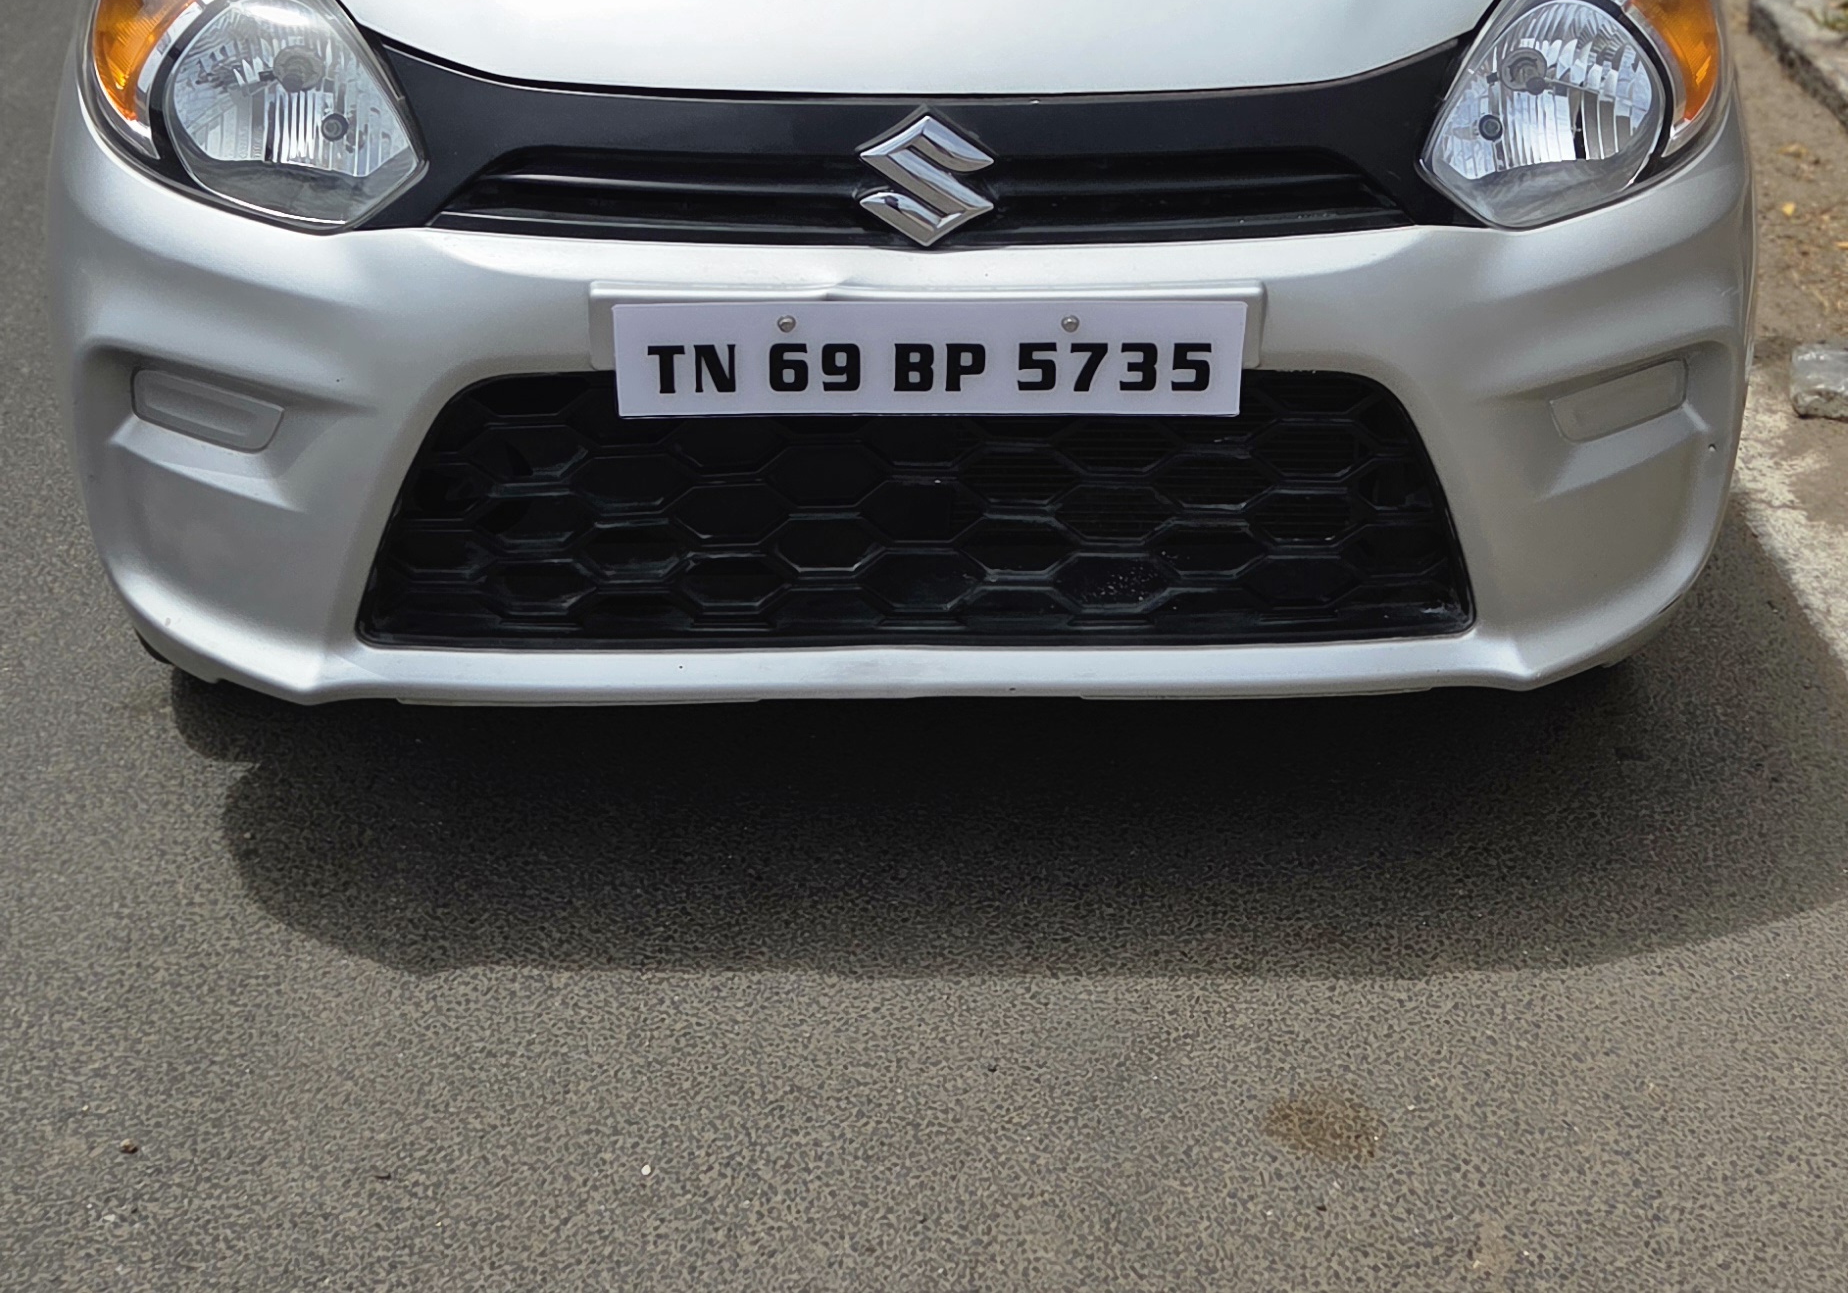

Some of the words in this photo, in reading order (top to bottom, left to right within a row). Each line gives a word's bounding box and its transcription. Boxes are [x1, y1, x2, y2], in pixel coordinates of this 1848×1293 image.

[647, 343, 737, 395] TN
[768, 342, 861, 393] 69
[893, 342, 986, 393] BP
[1016, 341, 1212, 393] 5735
